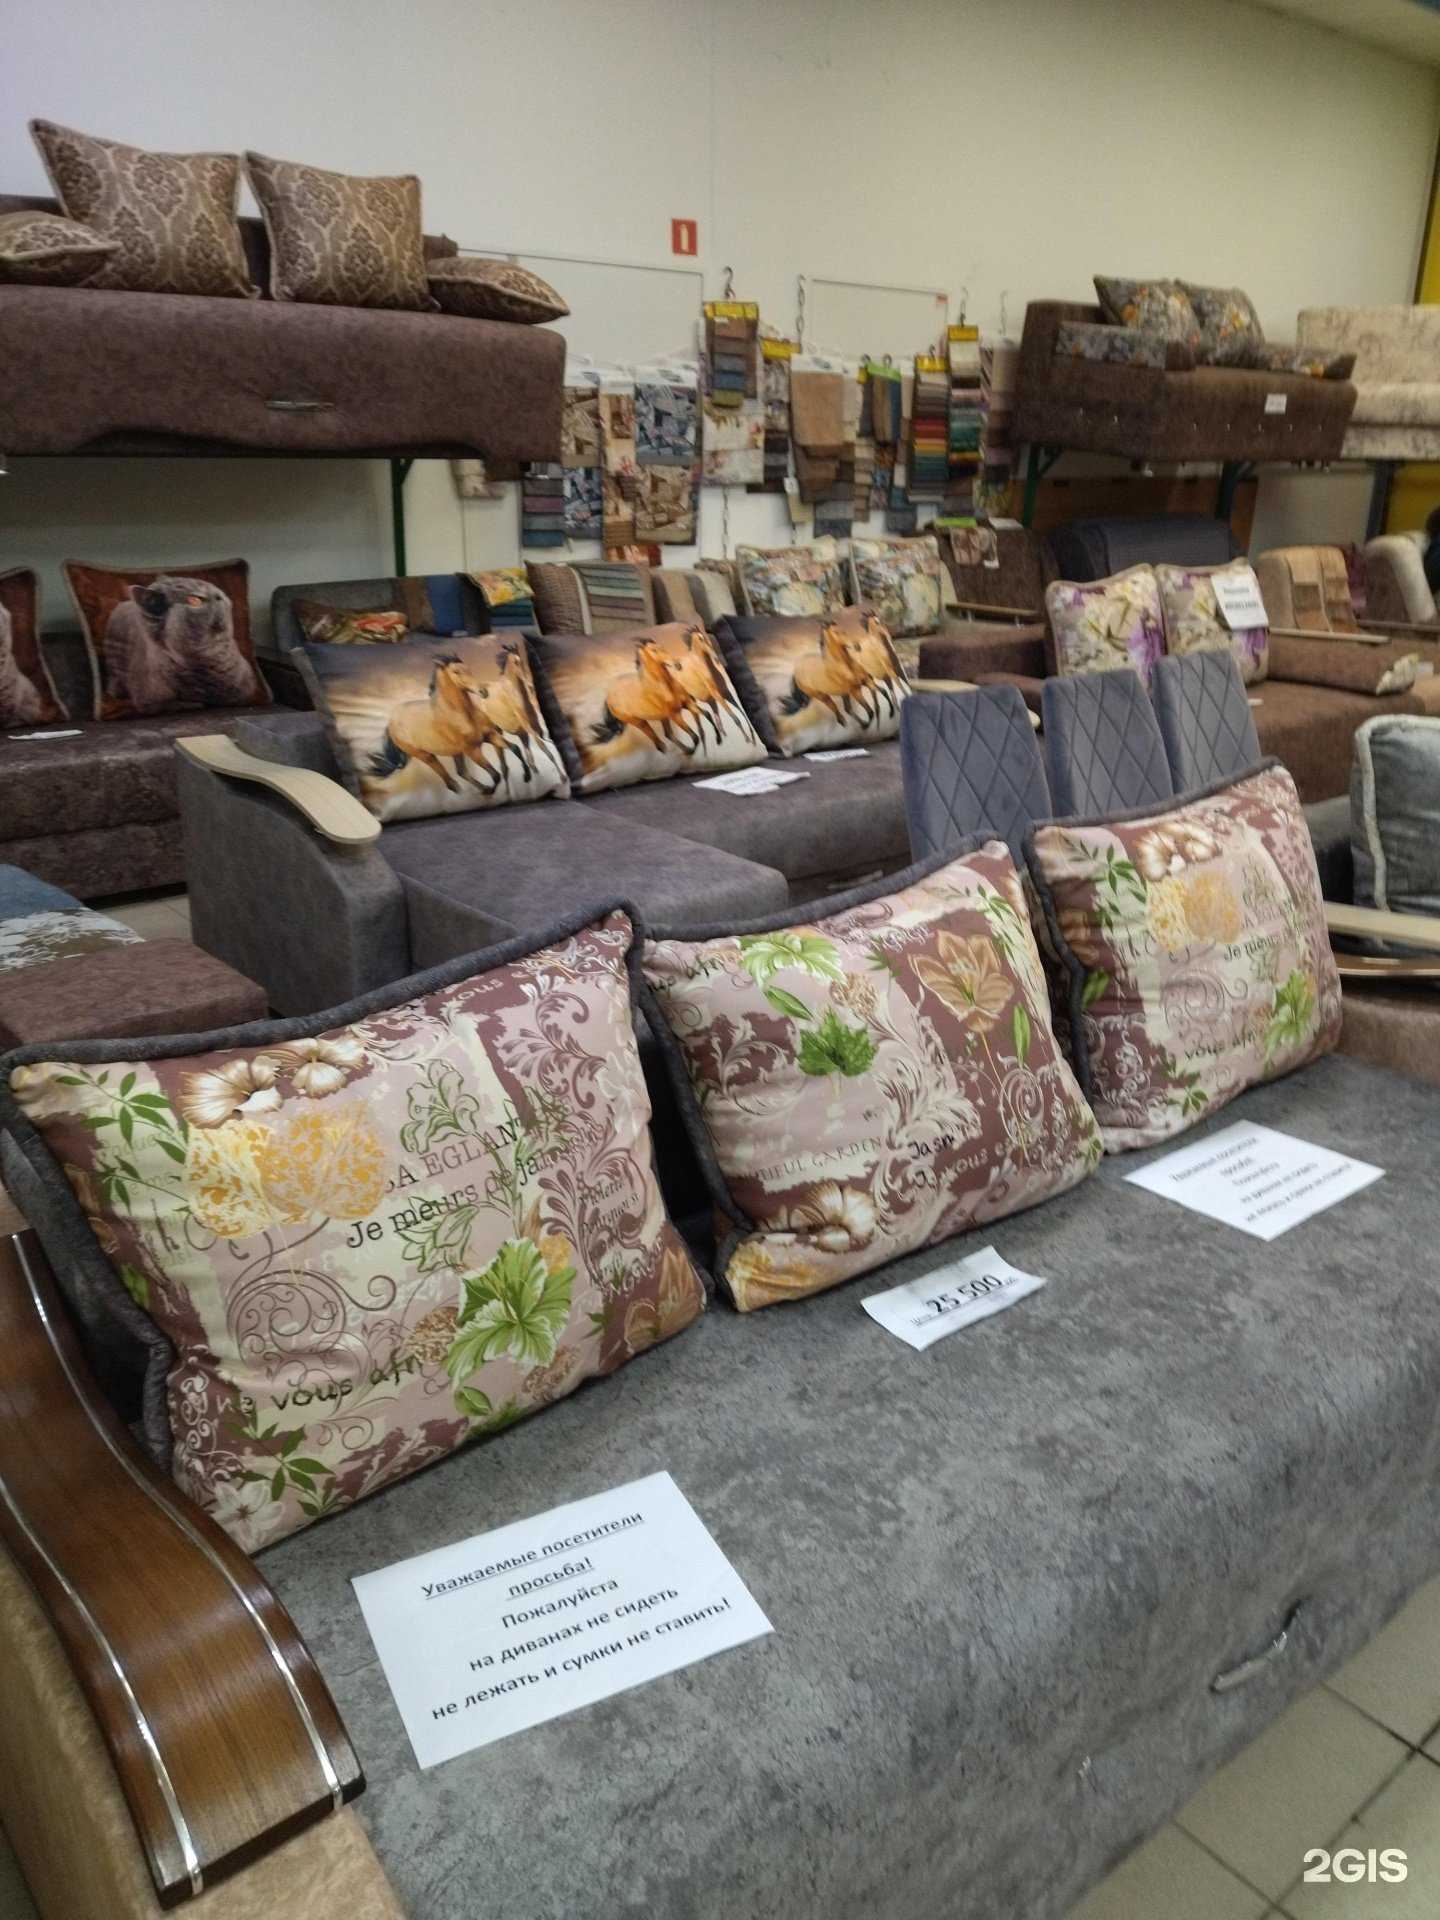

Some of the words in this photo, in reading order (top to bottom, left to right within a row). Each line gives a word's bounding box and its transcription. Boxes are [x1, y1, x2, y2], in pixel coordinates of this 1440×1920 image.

[346, 1220, 383, 1249] Je
[926, 1294, 961, 1315] 25
[957, 1275, 1003, 1298] 500
[421, 1550, 538, 1597] Уважаемые
[541, 1513, 643, 1556] посетители
[507, 1556, 593, 1596] просьба!
[501, 1580, 619, 1629] Пожалуйста
[469, 1655, 495, 1671] на
[500, 1623, 583, 1664] диванах
[586, 1612, 610, 1629] не
[614, 1588, 679, 1618] сидеть
[431, 1702, 458, 1719] не
[464, 1672, 540, 1708] лежать
[544, 1665, 557, 1678] и
[562, 1640, 623, 1671] сумки
[626, 1630, 650, 1647] не
[654, 1596, 731, 1635] ставить!
